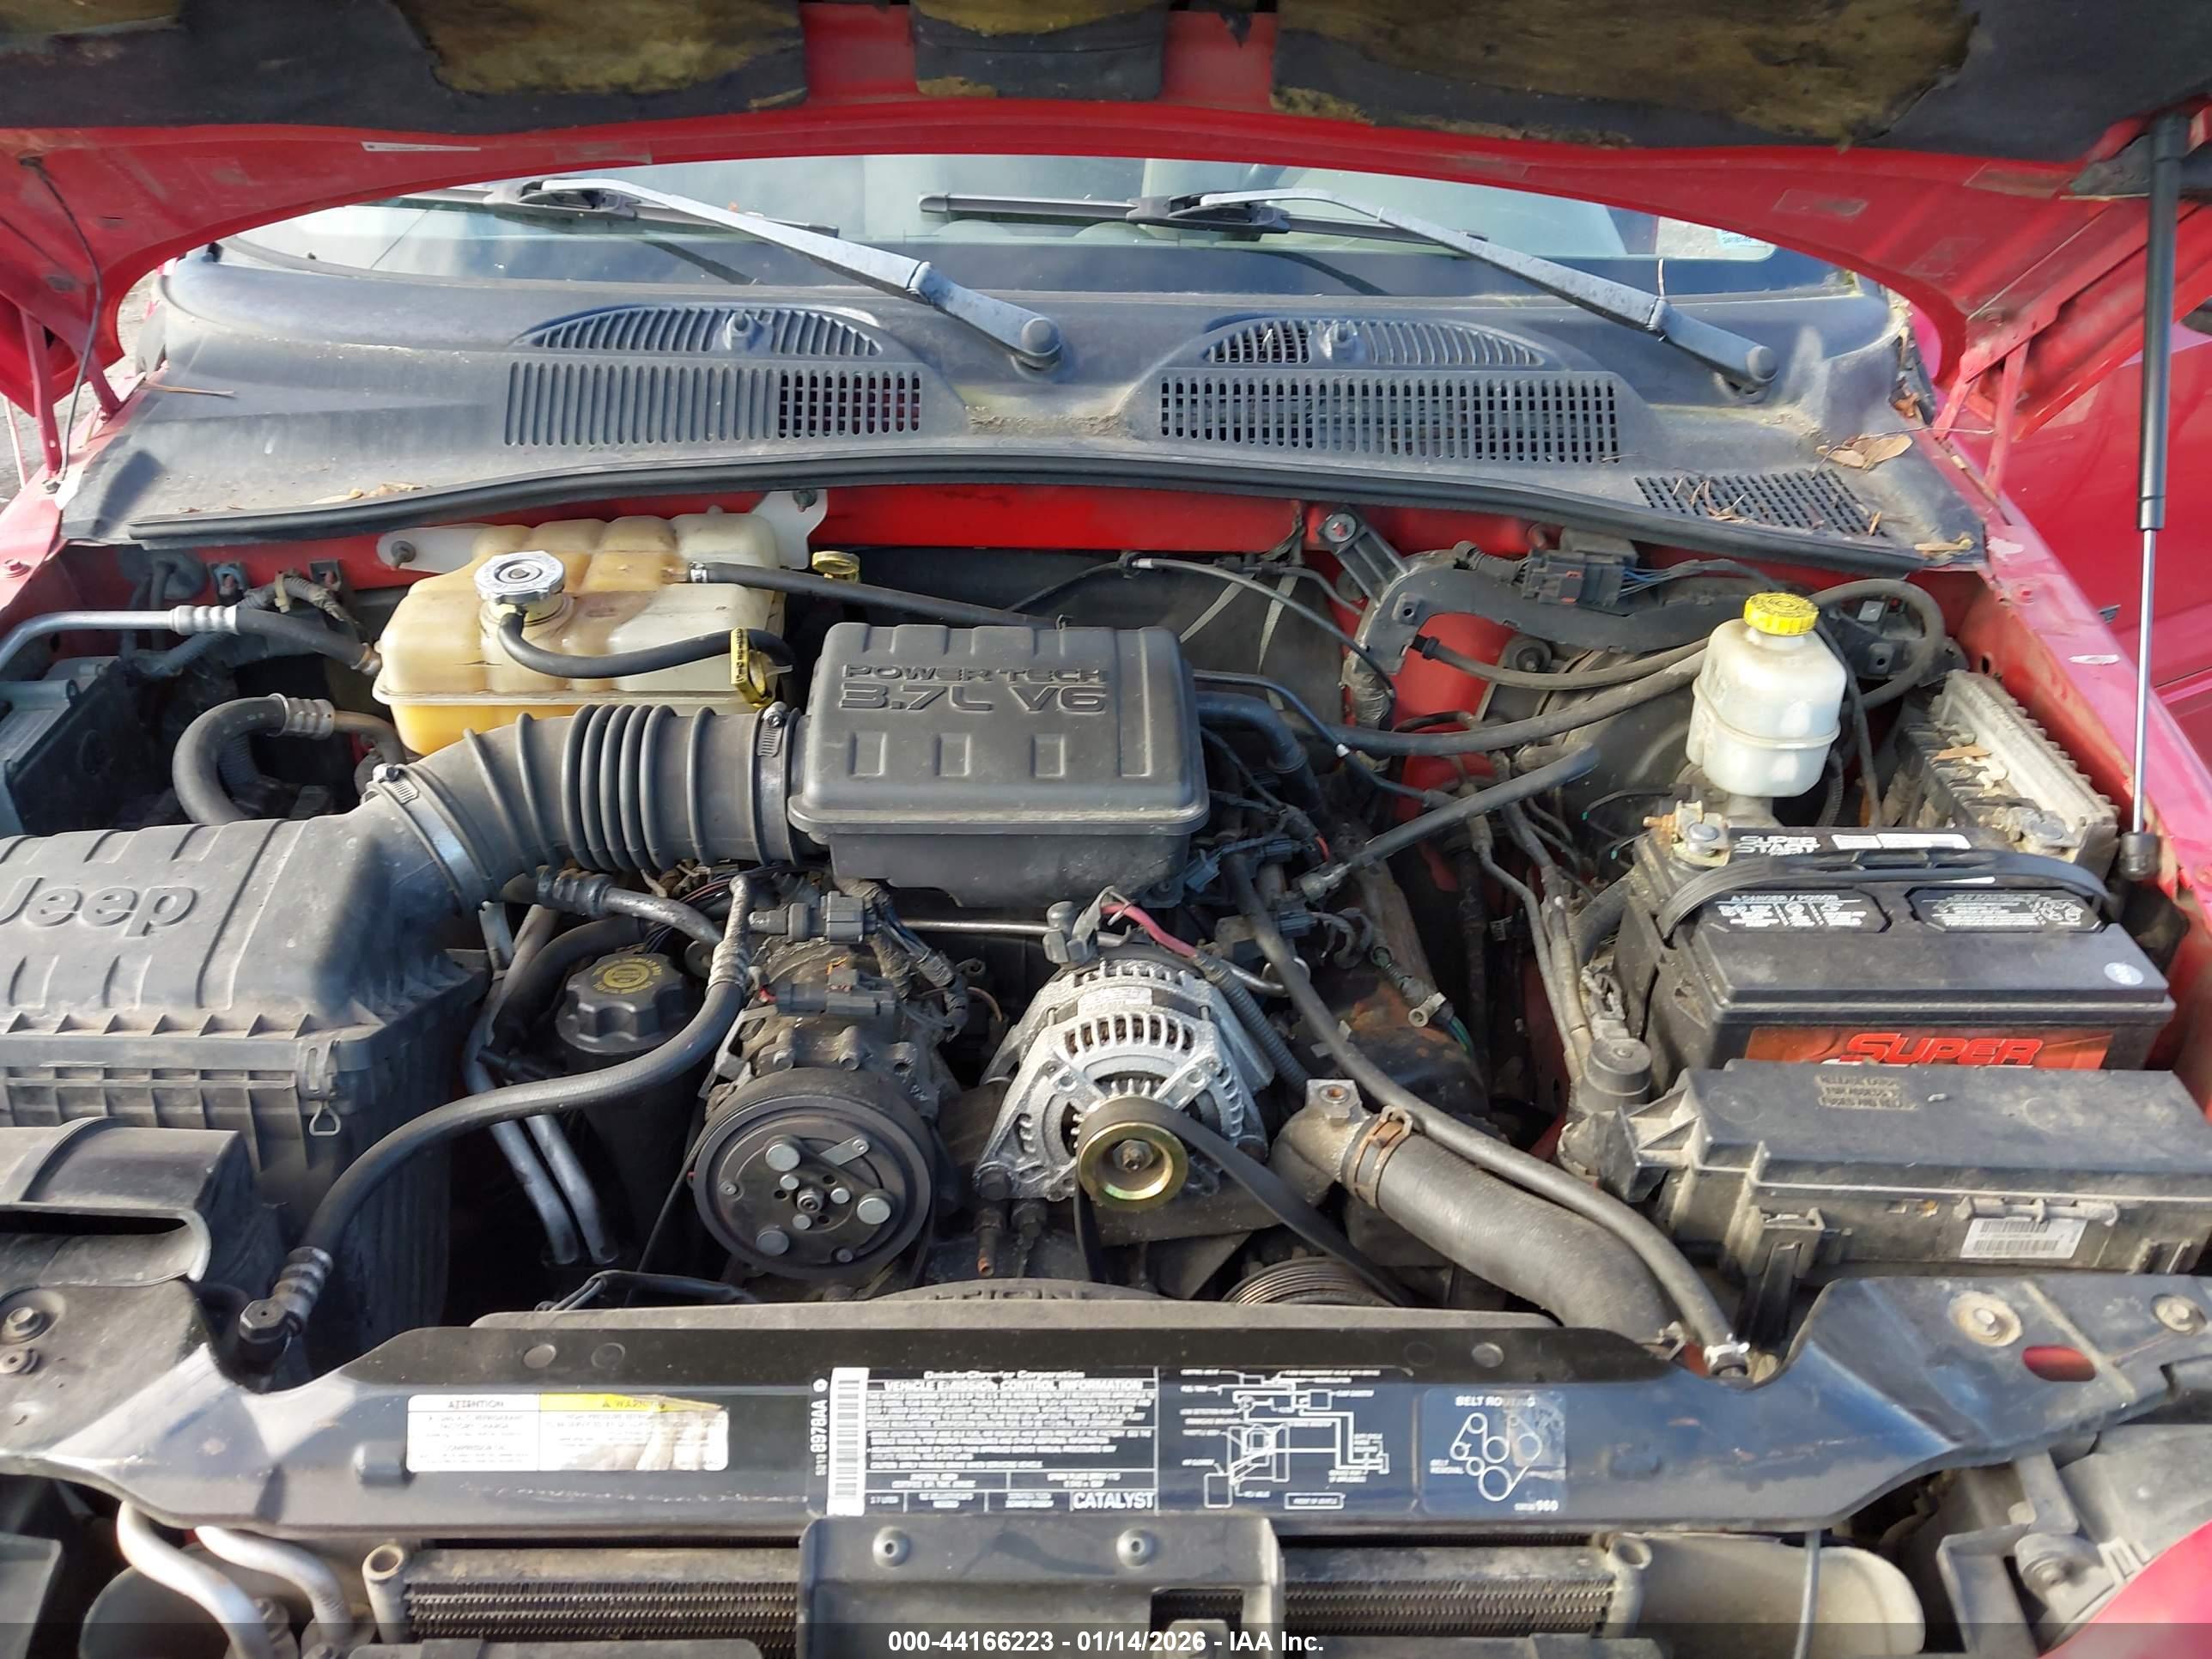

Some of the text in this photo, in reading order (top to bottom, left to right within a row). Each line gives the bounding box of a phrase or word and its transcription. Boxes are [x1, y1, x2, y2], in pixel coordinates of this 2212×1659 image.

[838, 682, 1108, 714] 3.7L V6
[1740, 835, 1818, 846] SUPER
[0, 874, 199, 939] Jeep
[1844, 1033, 2044, 1065] SUPER
[1455, 1395, 1484, 1407] BELT
[1072, 1492, 1155, 1509] CATALYST
